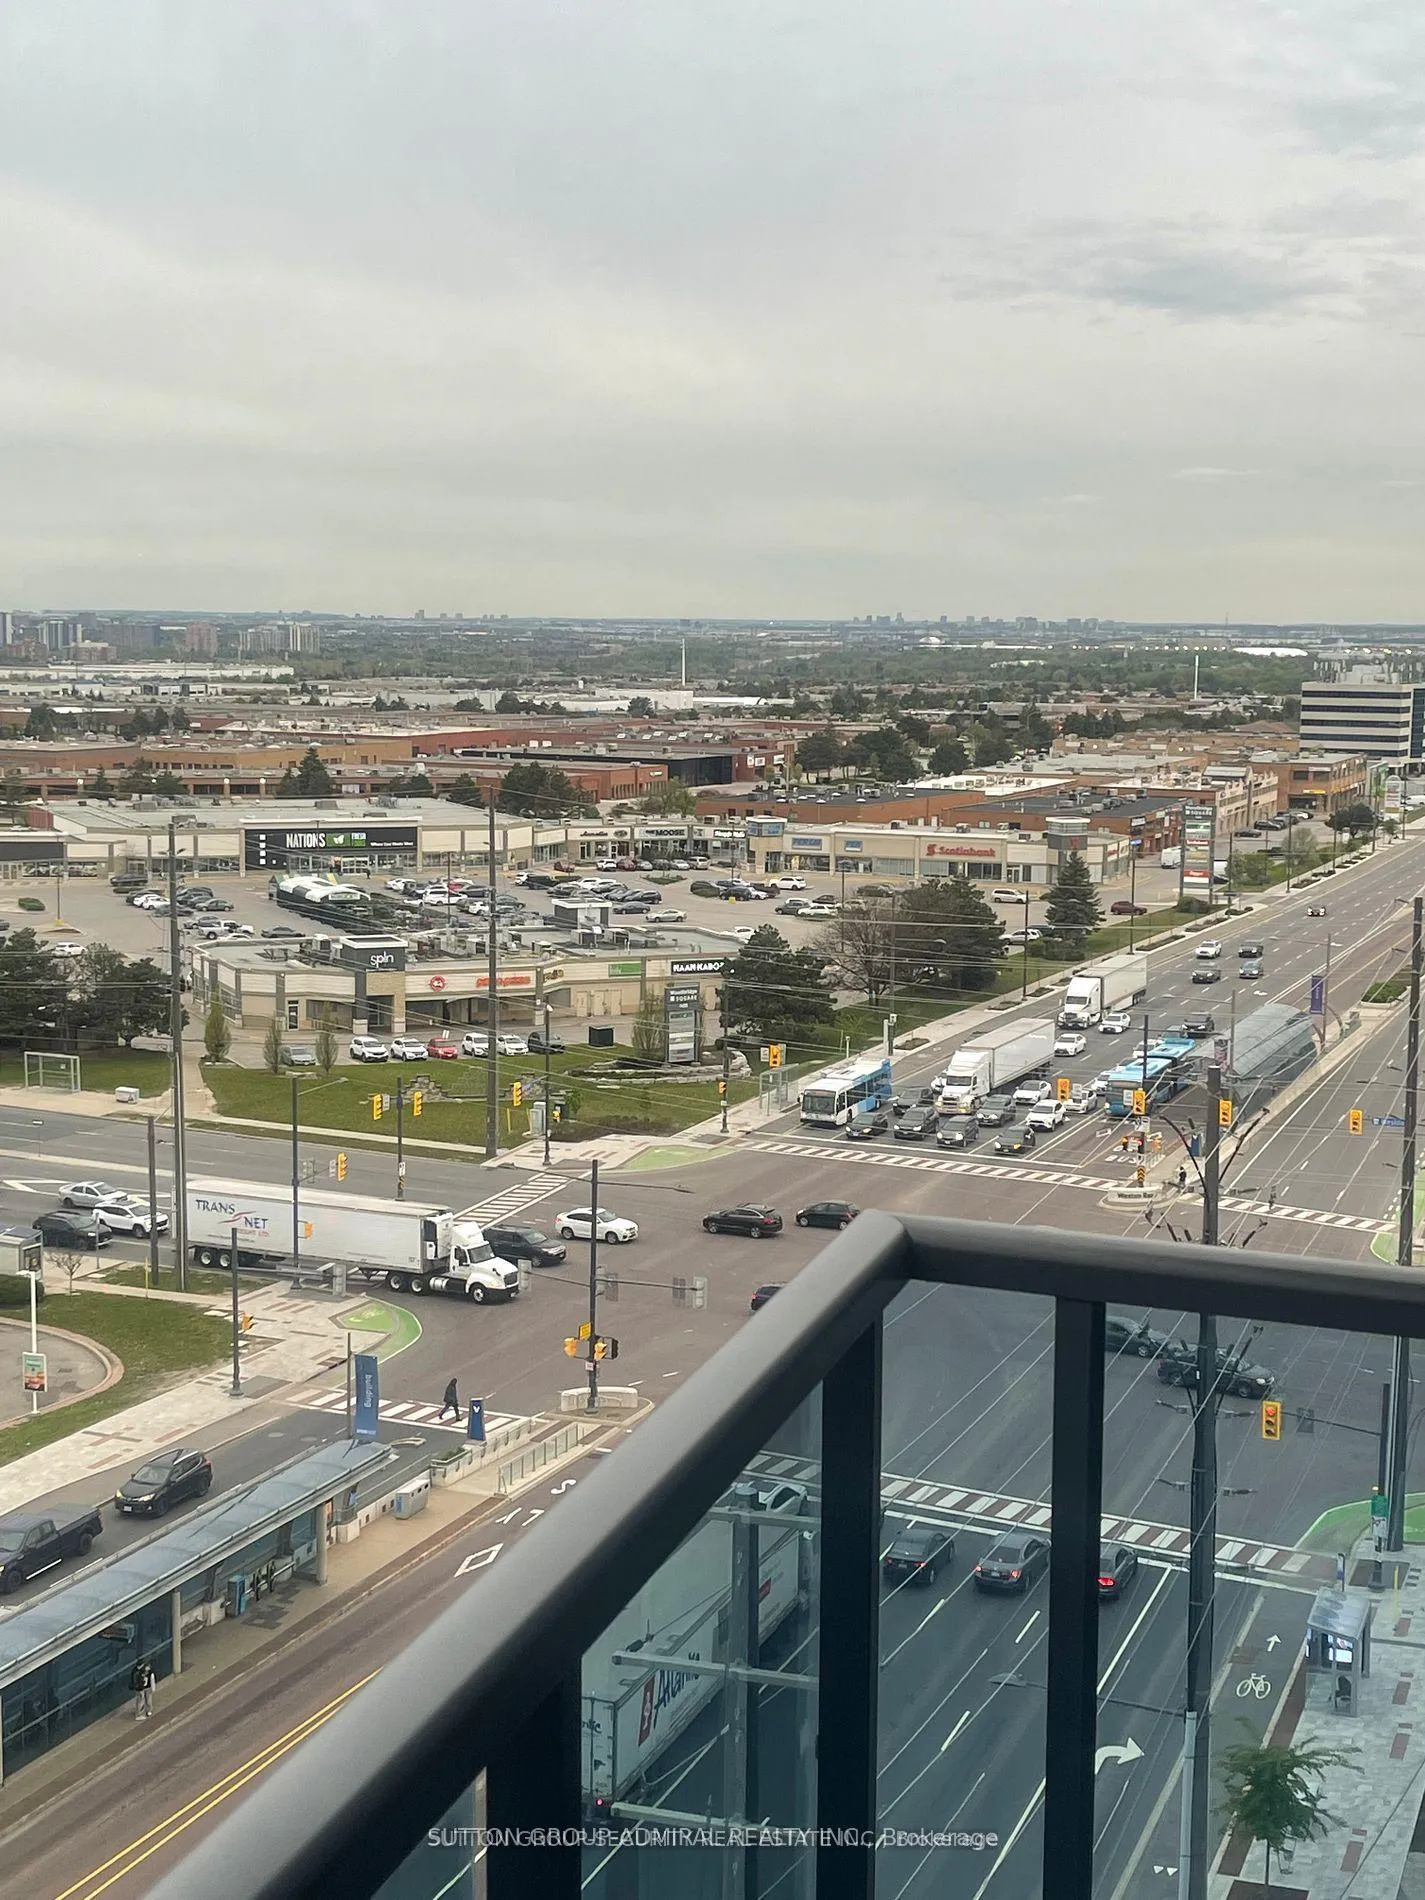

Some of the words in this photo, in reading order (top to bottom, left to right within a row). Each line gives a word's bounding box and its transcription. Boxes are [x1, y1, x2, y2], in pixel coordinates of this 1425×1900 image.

[286, 832, 326, 848] NATIONS
[938, 845, 996, 858] Scotiabank
[195, 1199, 236, 1215] TRANS
[244, 1216, 269, 1230] NET
